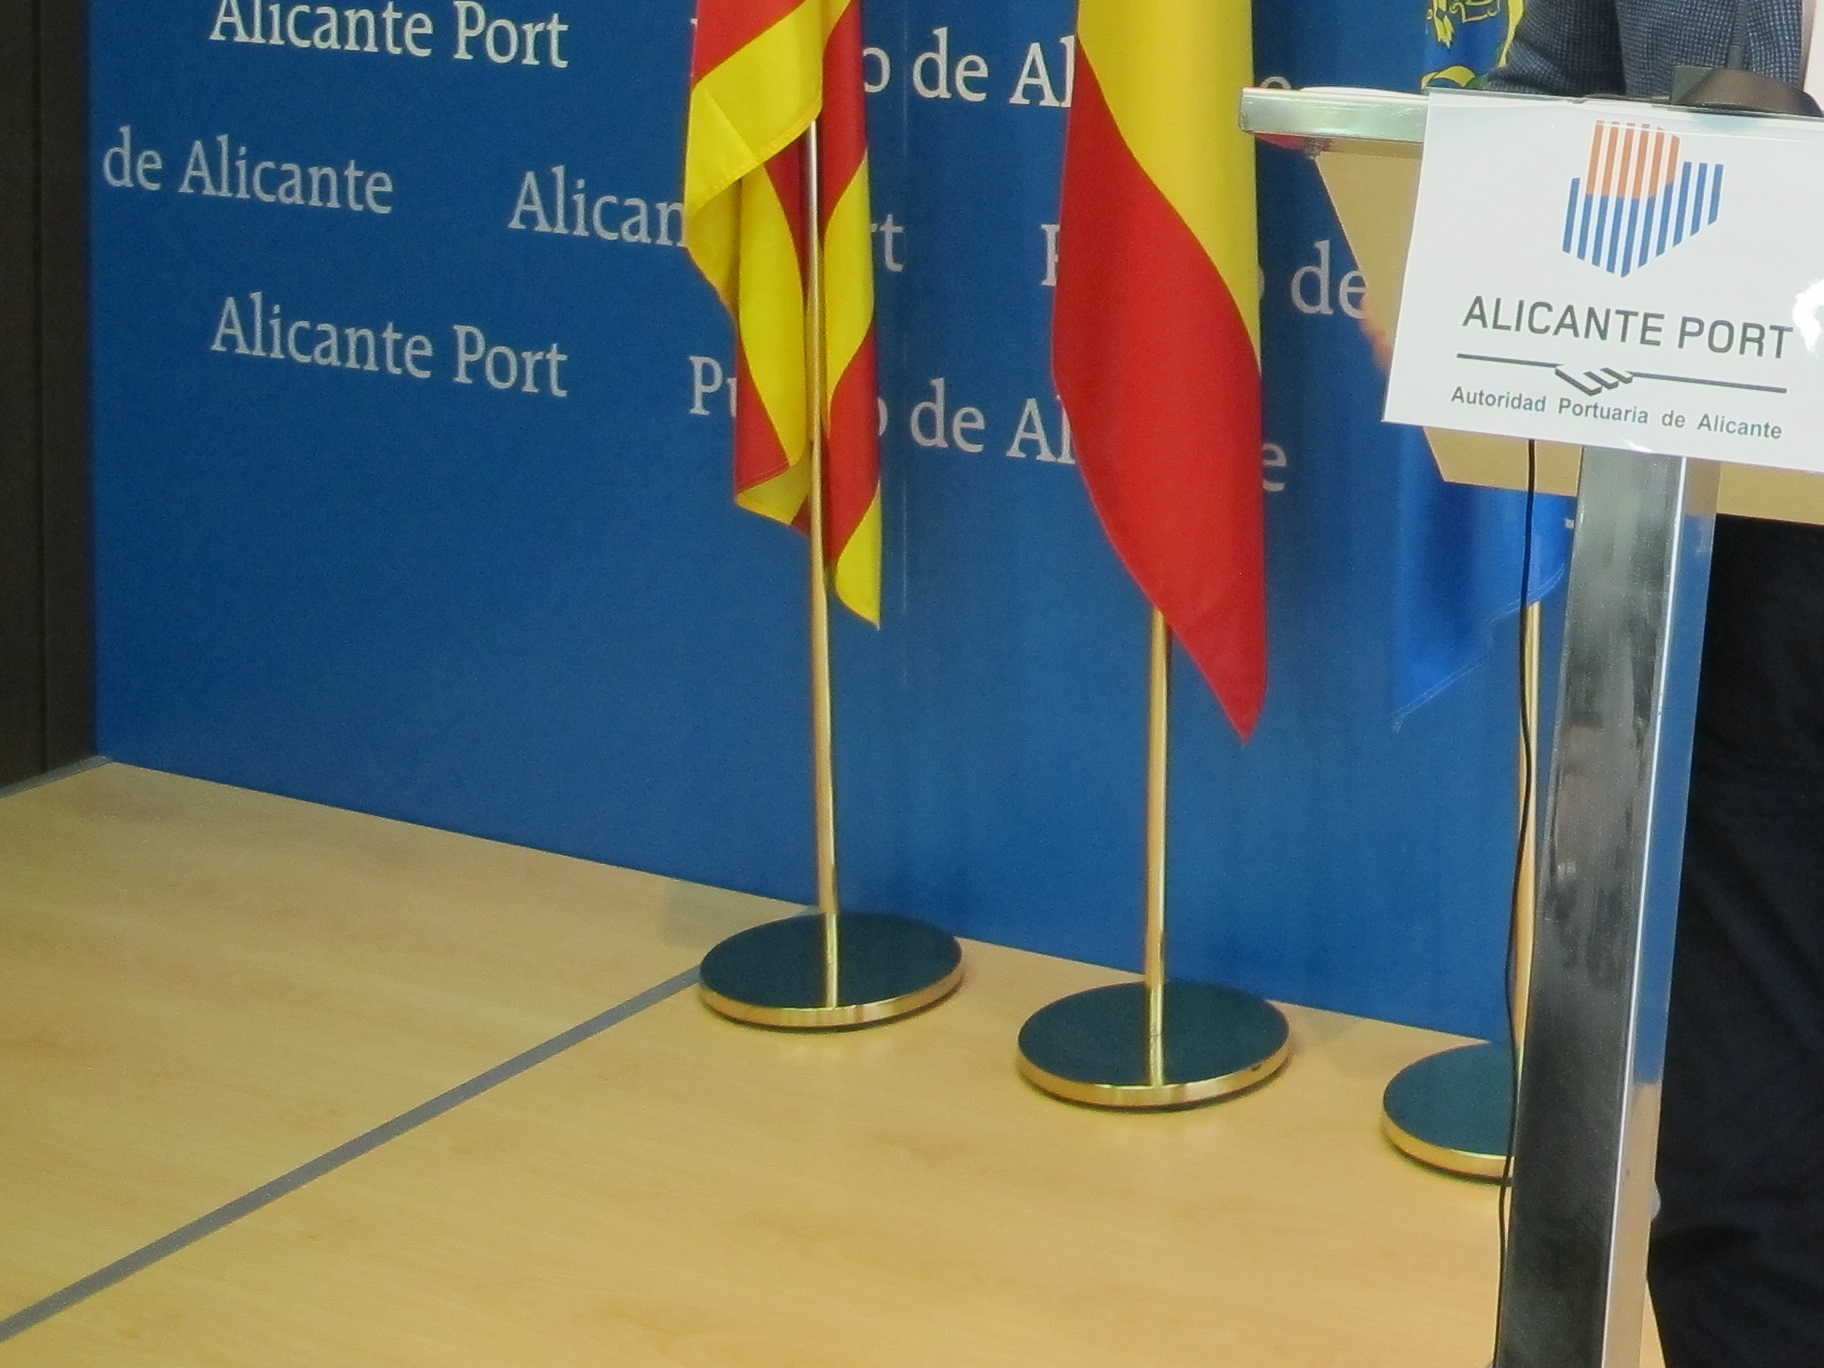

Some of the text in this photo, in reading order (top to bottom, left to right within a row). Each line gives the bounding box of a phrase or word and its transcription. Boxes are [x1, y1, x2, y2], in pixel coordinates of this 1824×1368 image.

[453, 0, 568, 68] Port
[912, 27, 989, 102] de
[104, 126, 392, 213] de Alicante
[509, 165, 687, 248] Alican
[211, 292, 567, 397] Alicante Port
[1463, 295, 1793, 359] ALICANTE PORT
[906, 376, 986, 453] de
[1451, 387, 1782, 439] Autoridad Portuaria de Alicante
